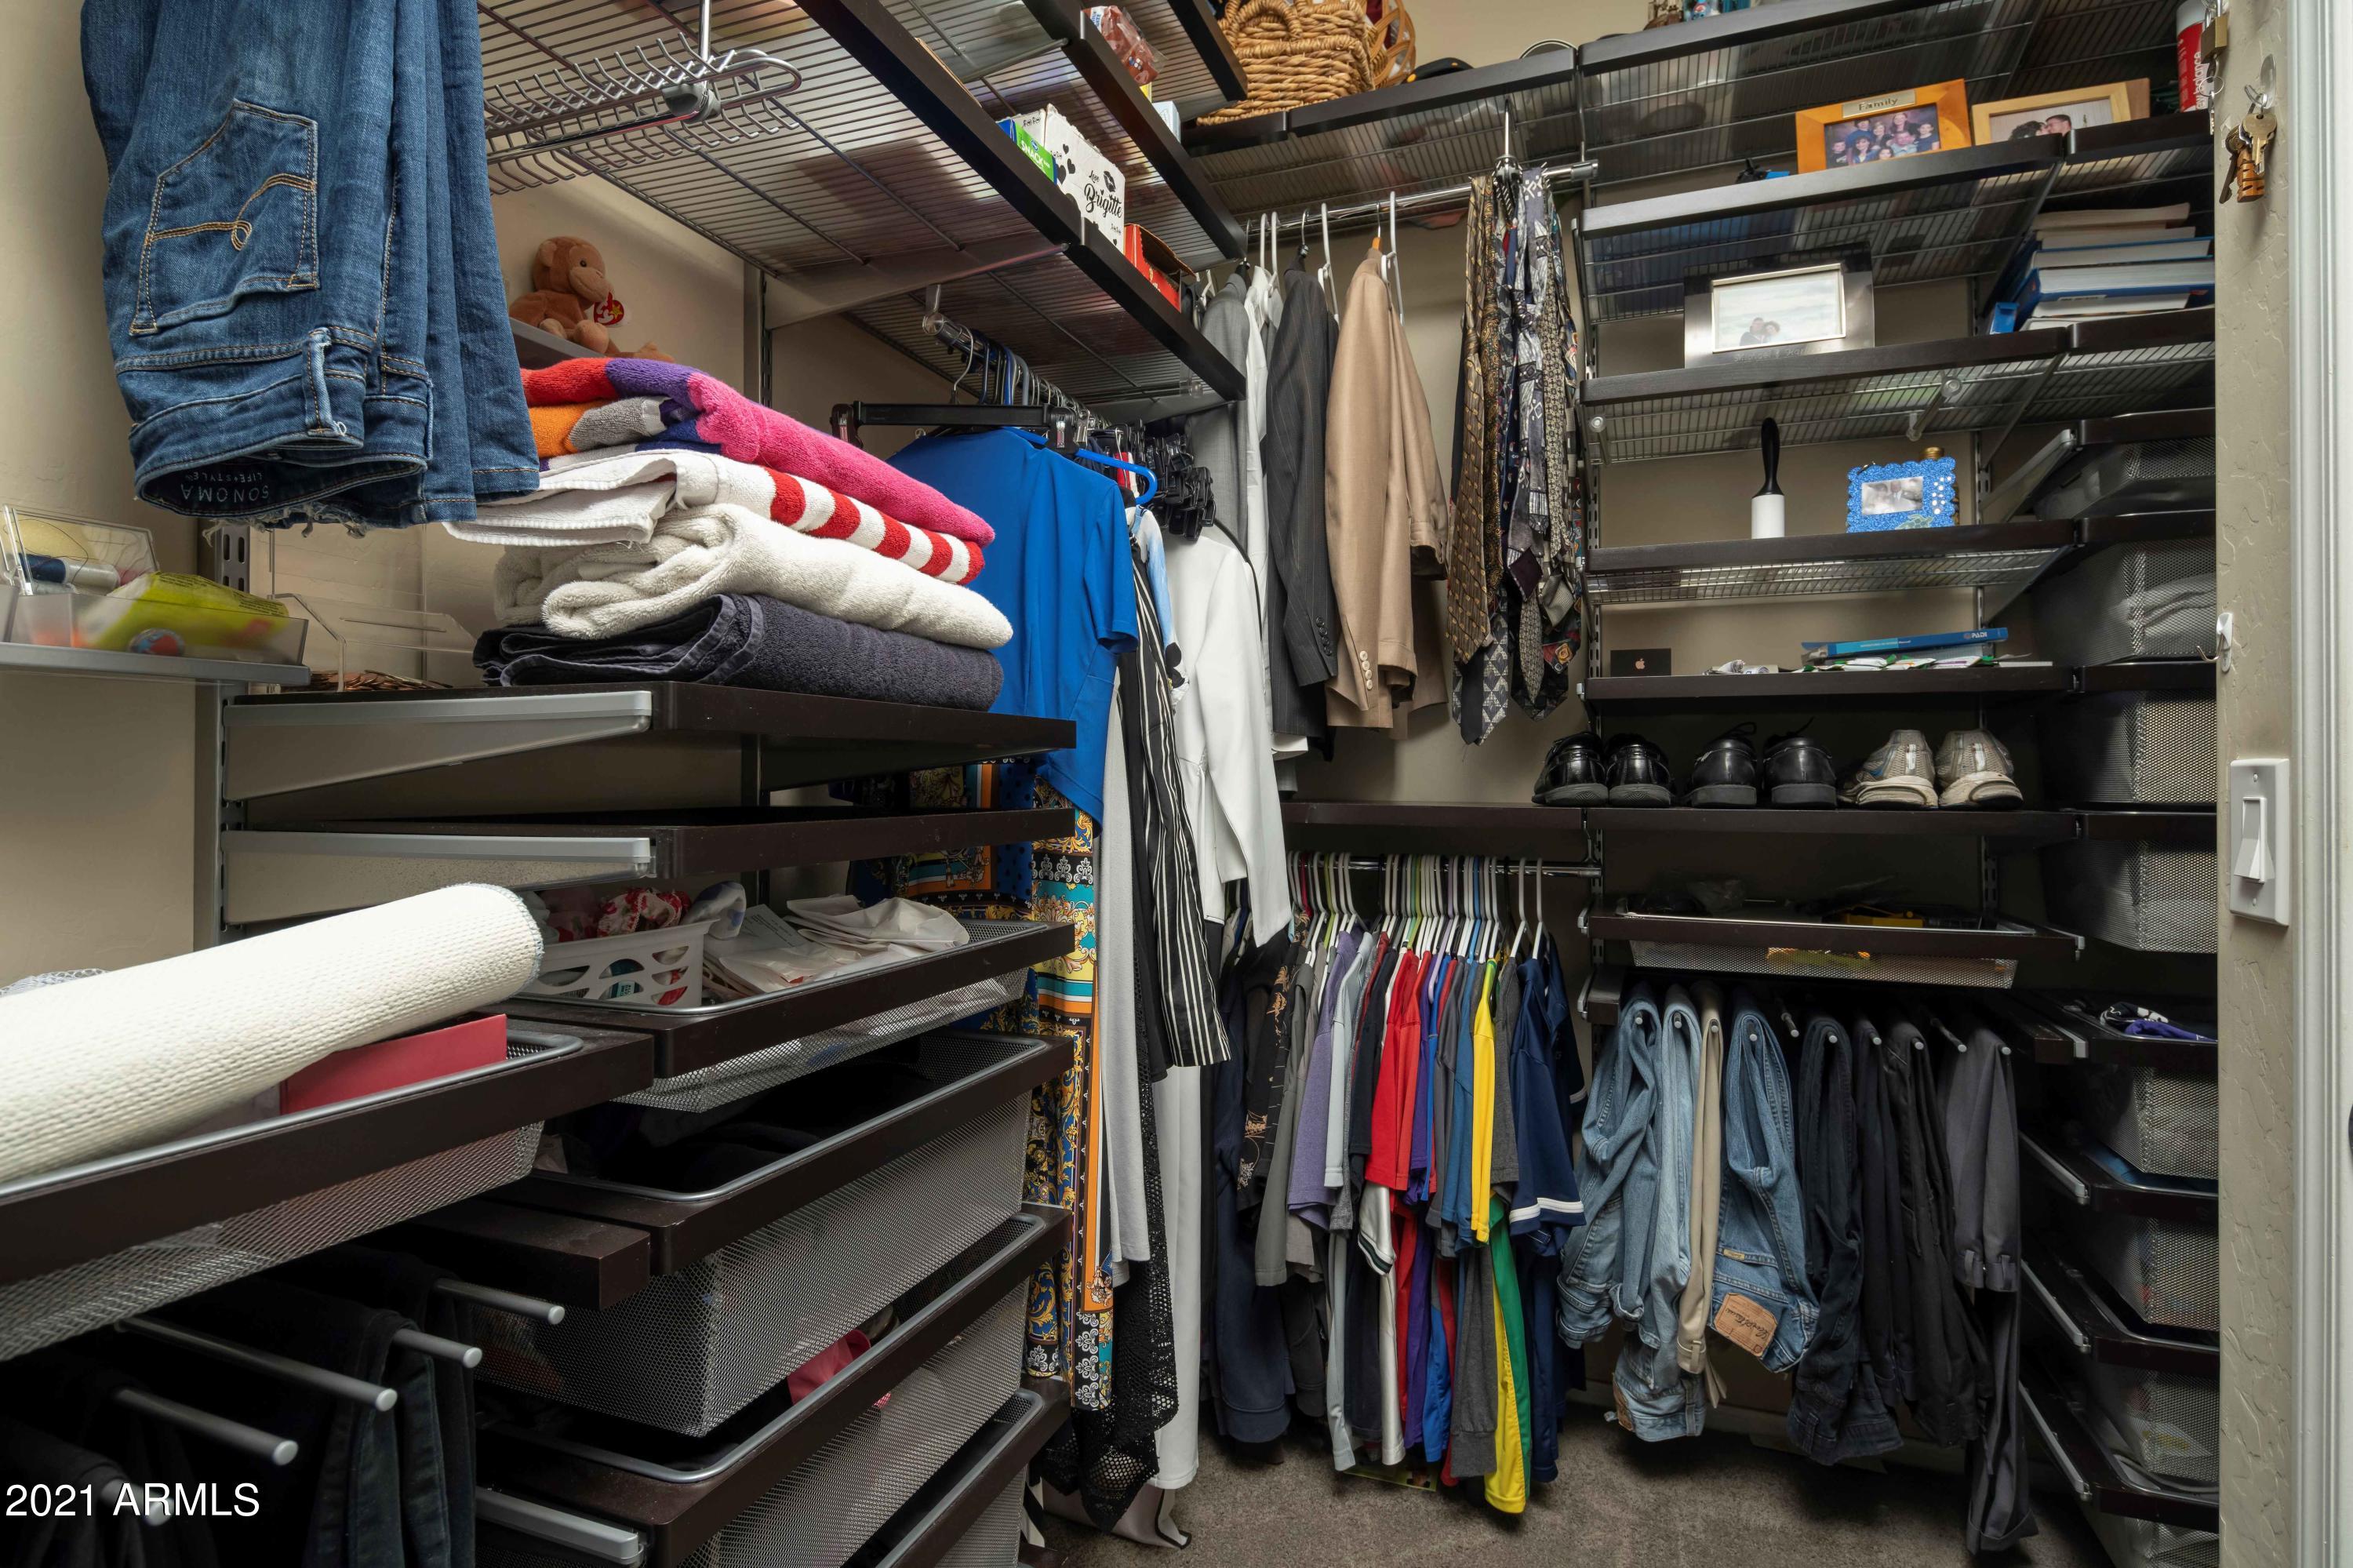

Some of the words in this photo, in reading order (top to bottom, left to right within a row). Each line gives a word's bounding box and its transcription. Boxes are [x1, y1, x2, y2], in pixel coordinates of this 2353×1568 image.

[1858, 97, 1898, 111] Family
[1021, 140, 1043, 168] SNACK
[1084, 183, 1122, 218] Brigitte
[180, 483, 270, 503] SONOMA
